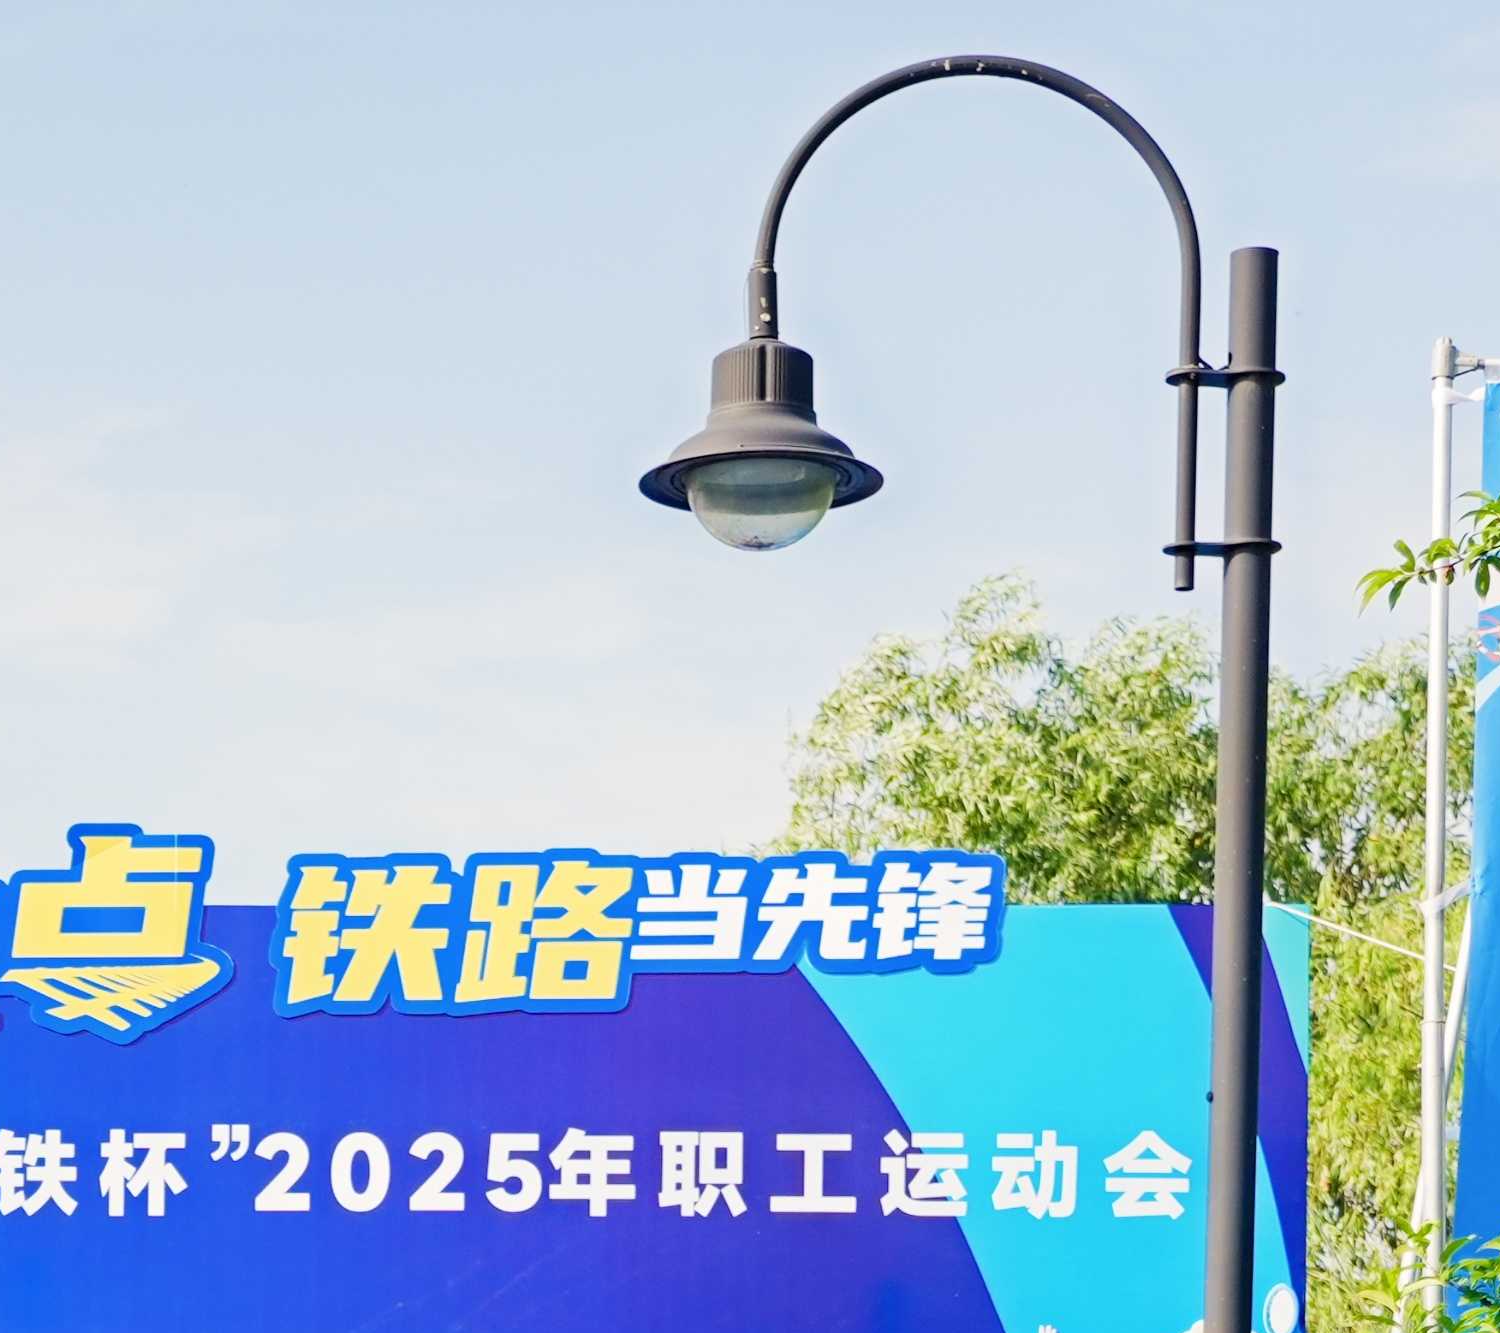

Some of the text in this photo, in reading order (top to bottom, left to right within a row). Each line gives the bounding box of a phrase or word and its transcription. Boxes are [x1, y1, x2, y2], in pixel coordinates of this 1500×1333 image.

[284, 861, 994, 1006] 铁路当先锋
